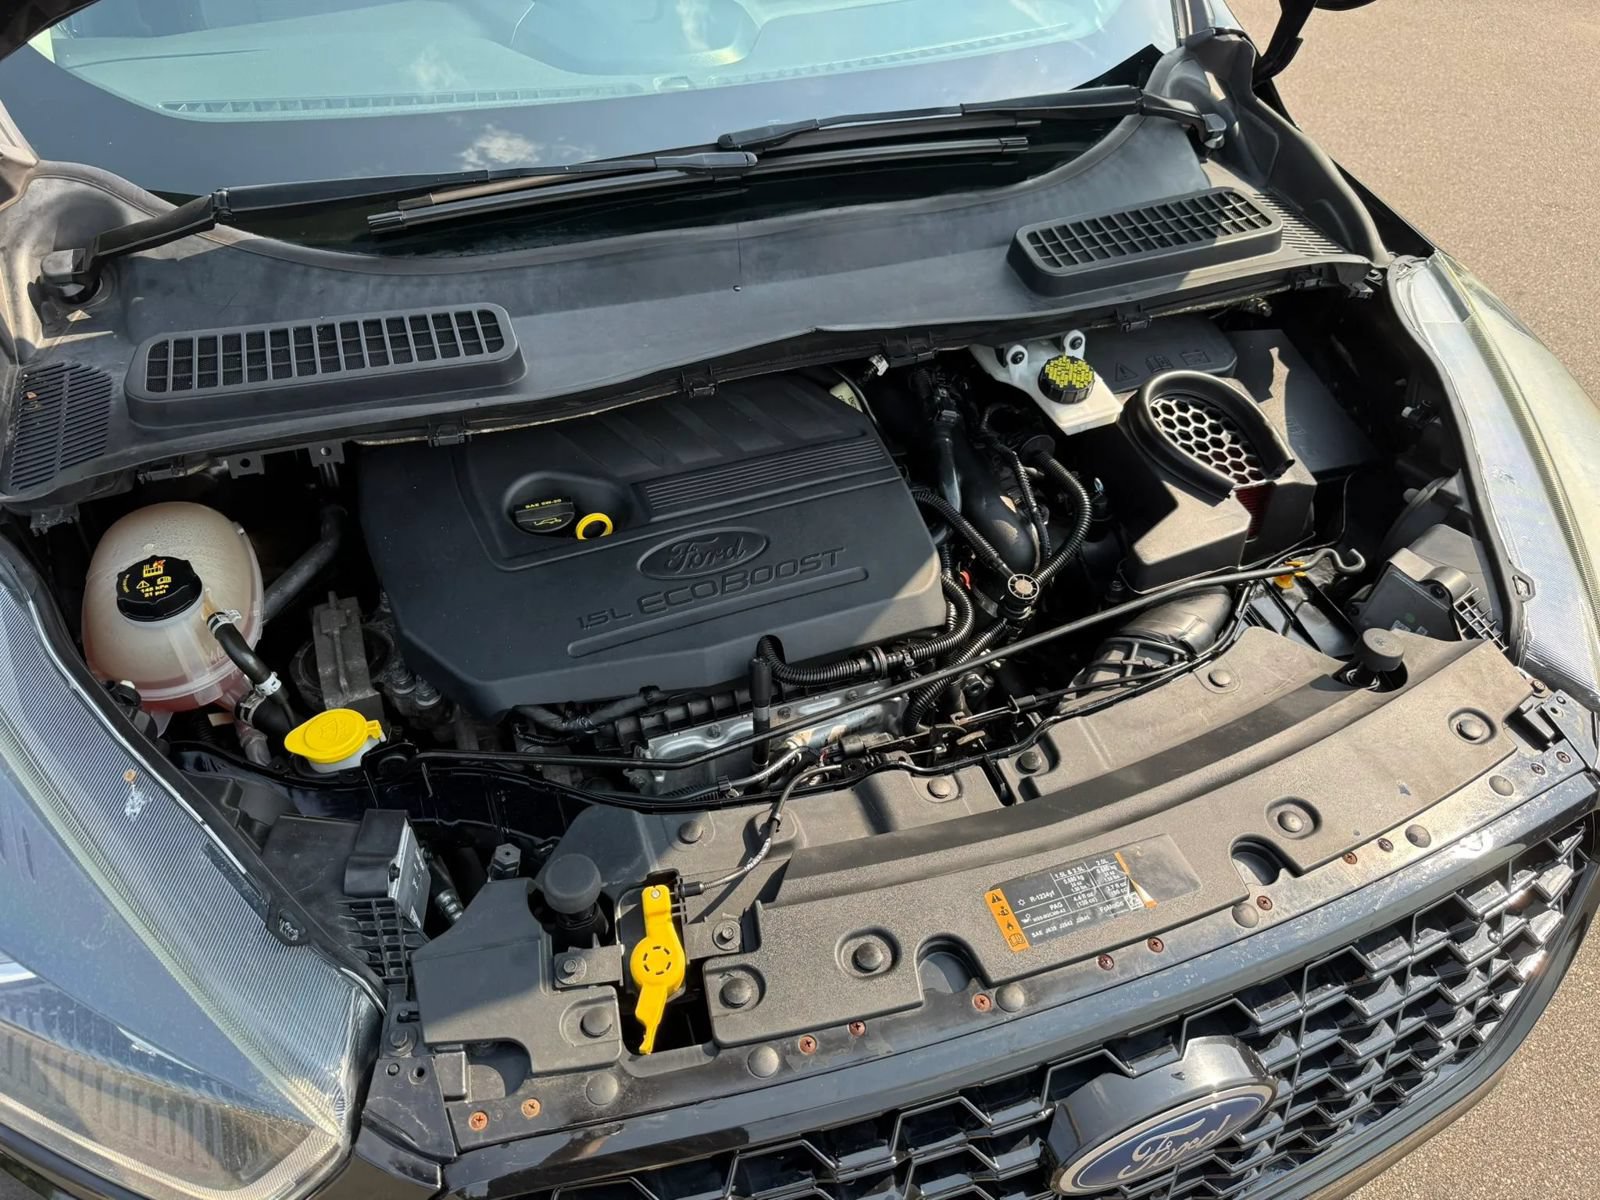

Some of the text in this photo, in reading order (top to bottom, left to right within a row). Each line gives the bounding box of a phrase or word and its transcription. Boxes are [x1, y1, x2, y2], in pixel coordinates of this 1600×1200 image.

[666, 535, 747, 574] Ford
[637, 547, 847, 616] ECOBOOST
[1029, 890, 1056, 903] R-1234yf
[1049, 901, 1063, 910] PAG
[1031, 930, 1043, 938] SAE
[1117, 1114, 1231, 1180] Ford
